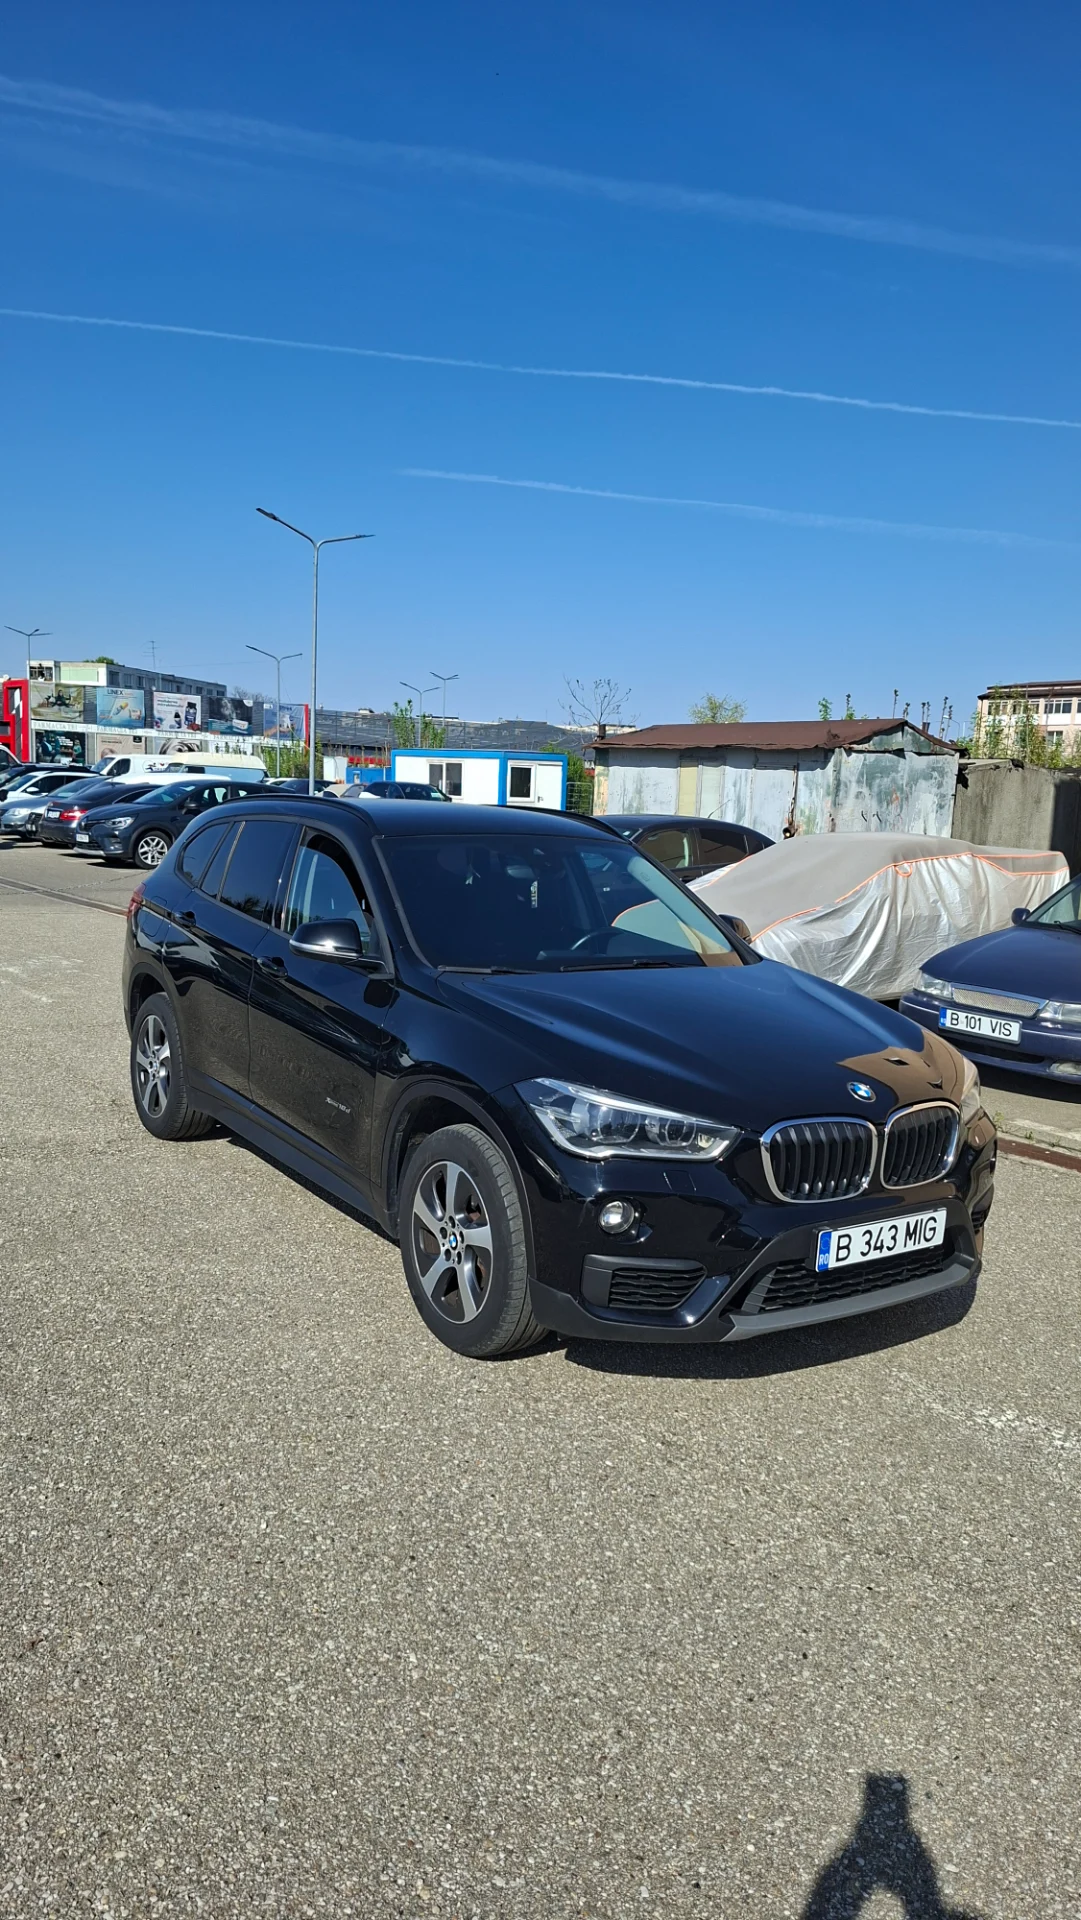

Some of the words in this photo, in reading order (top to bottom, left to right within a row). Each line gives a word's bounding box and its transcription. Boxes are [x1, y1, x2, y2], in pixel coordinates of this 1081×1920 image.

[950, 1012, 960, 1026] B
[964, 1014, 982, 1031] 101
[989, 1019, 1012, 1037] VIS
[835, 1234, 852, 1263] B
[860, 1224, 899, 1257] 343
[904, 1216, 938, 1248] MIG
[818, 1253, 829, 1266] RO
